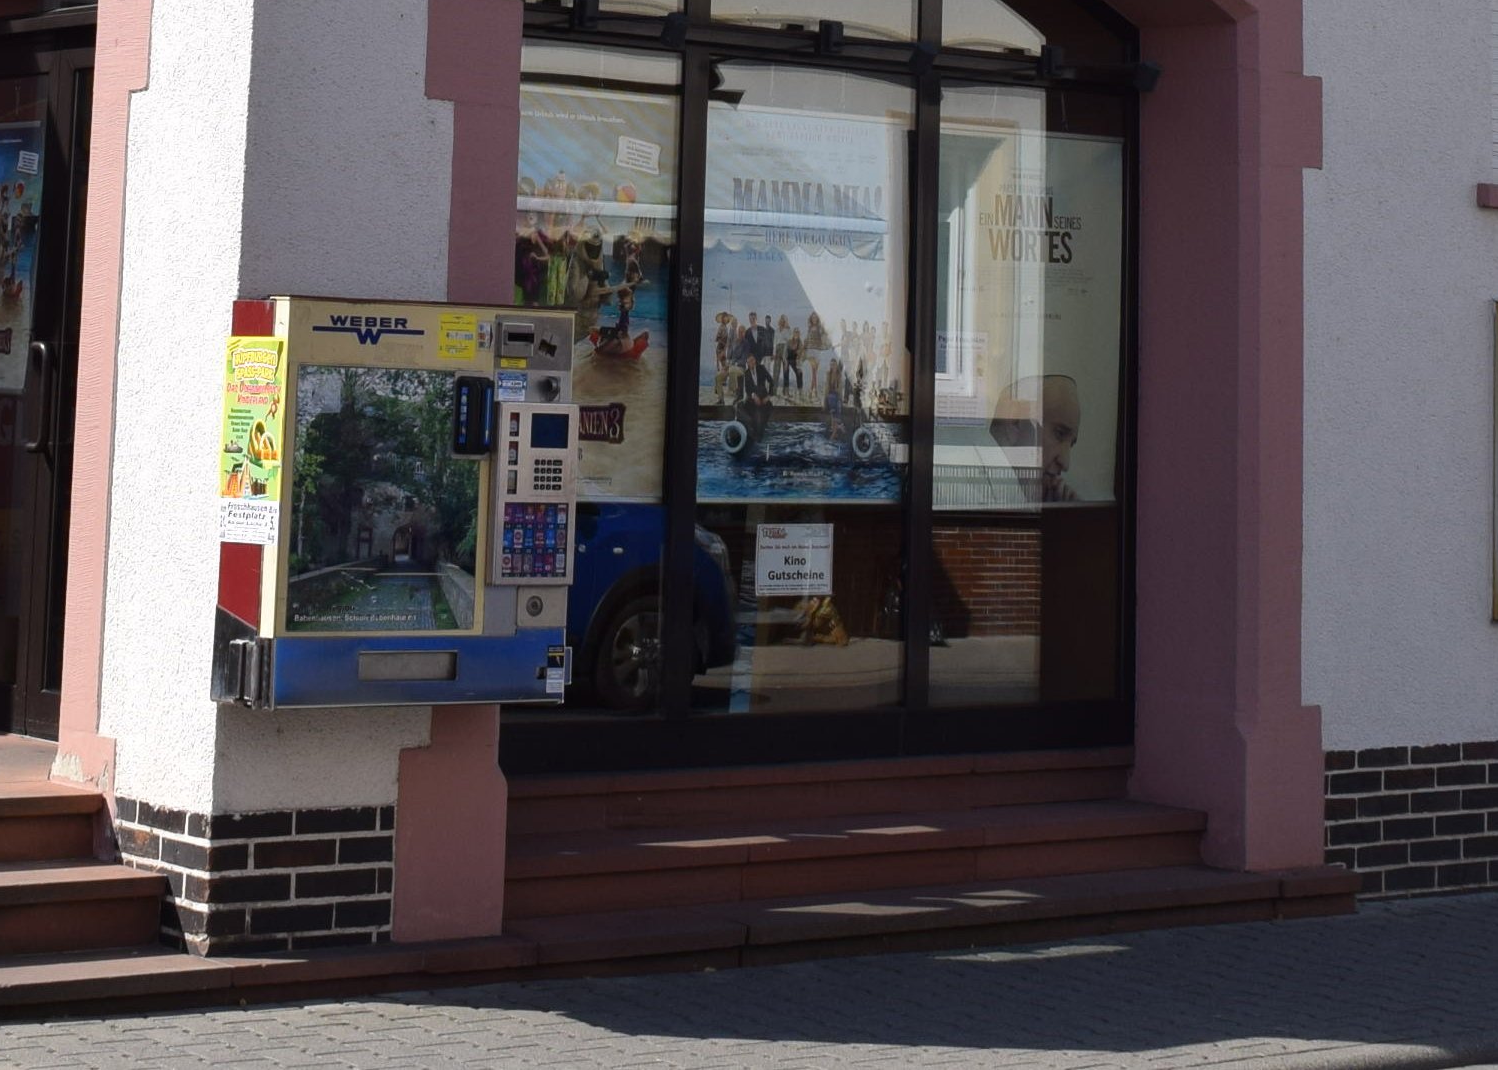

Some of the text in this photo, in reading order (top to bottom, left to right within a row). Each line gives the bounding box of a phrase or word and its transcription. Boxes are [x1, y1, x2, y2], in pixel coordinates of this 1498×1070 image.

[979, 194, 1082, 230] EIN MANN SEINES
[988, 228, 1073, 263] WORTES
[329, 315, 408, 329] WEBER
[783, 556, 807, 566] Kino
[767, 570, 825, 581] Gutscheine
